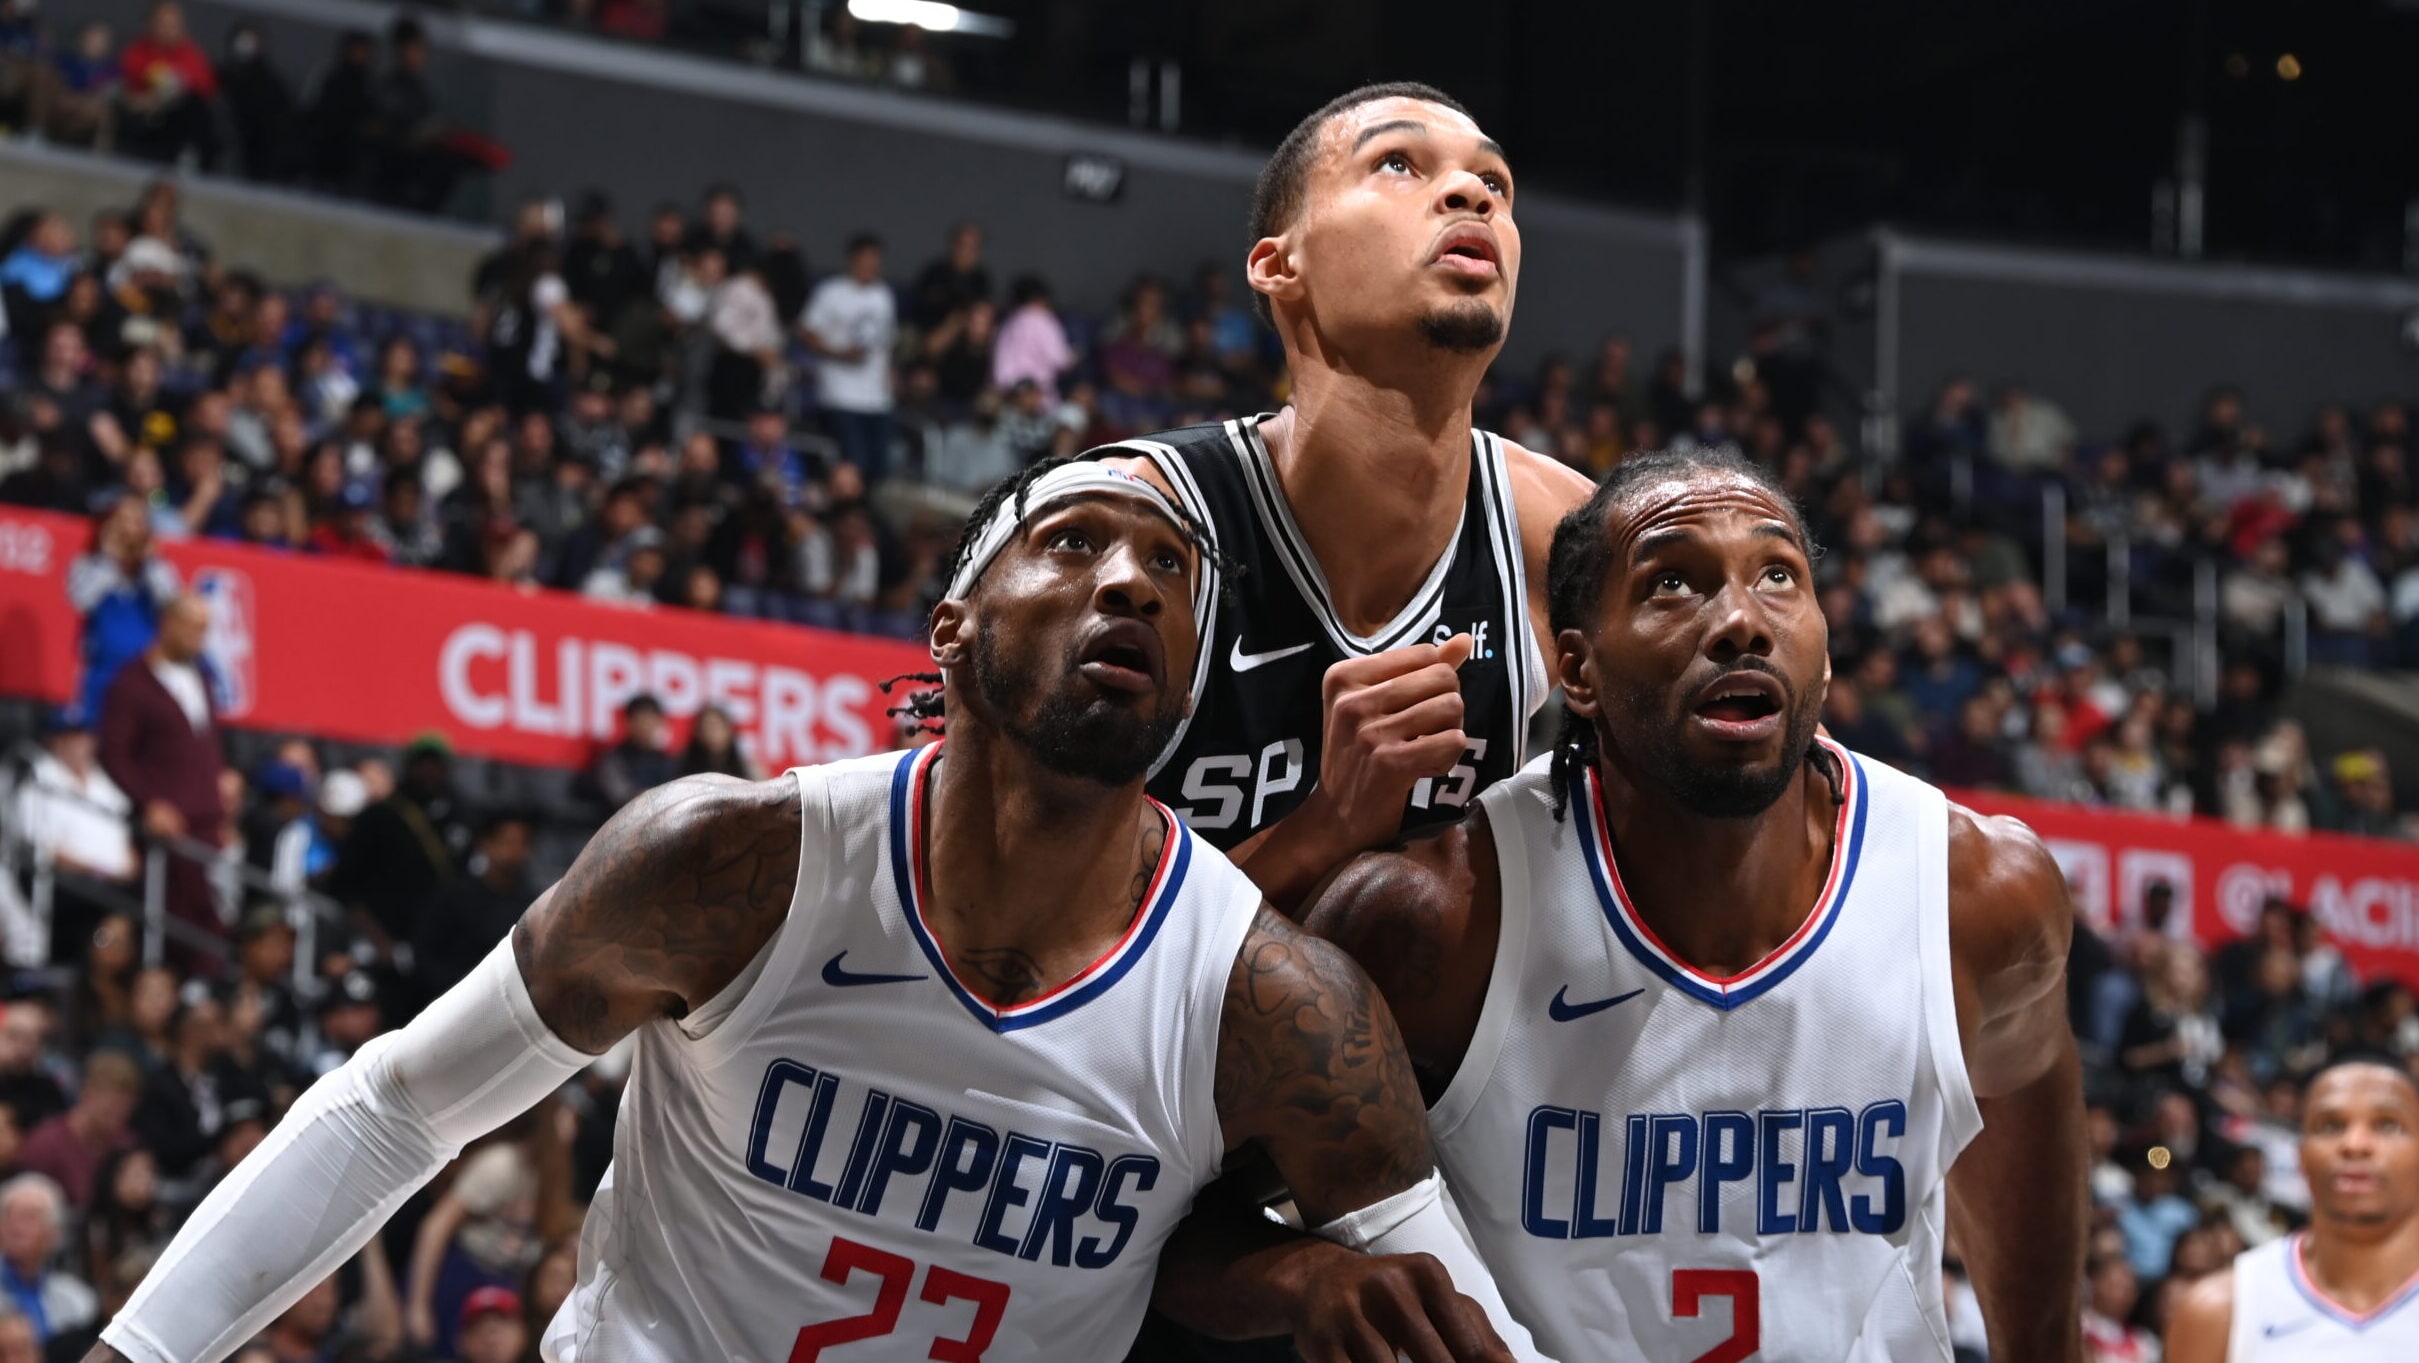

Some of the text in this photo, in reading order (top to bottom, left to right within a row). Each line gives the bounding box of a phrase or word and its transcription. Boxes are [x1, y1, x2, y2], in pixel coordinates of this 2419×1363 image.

[438, 622, 874, 765] CLIPPERS
[1432, 620, 1493, 660] Slf.
[1175, 737, 1487, 829] SPS
[745, 1057, 1161, 1269] CLIPPERS
[1521, 1100, 1906, 1239] CLIPPERS
[788, 1236, 1011, 1363] 23
